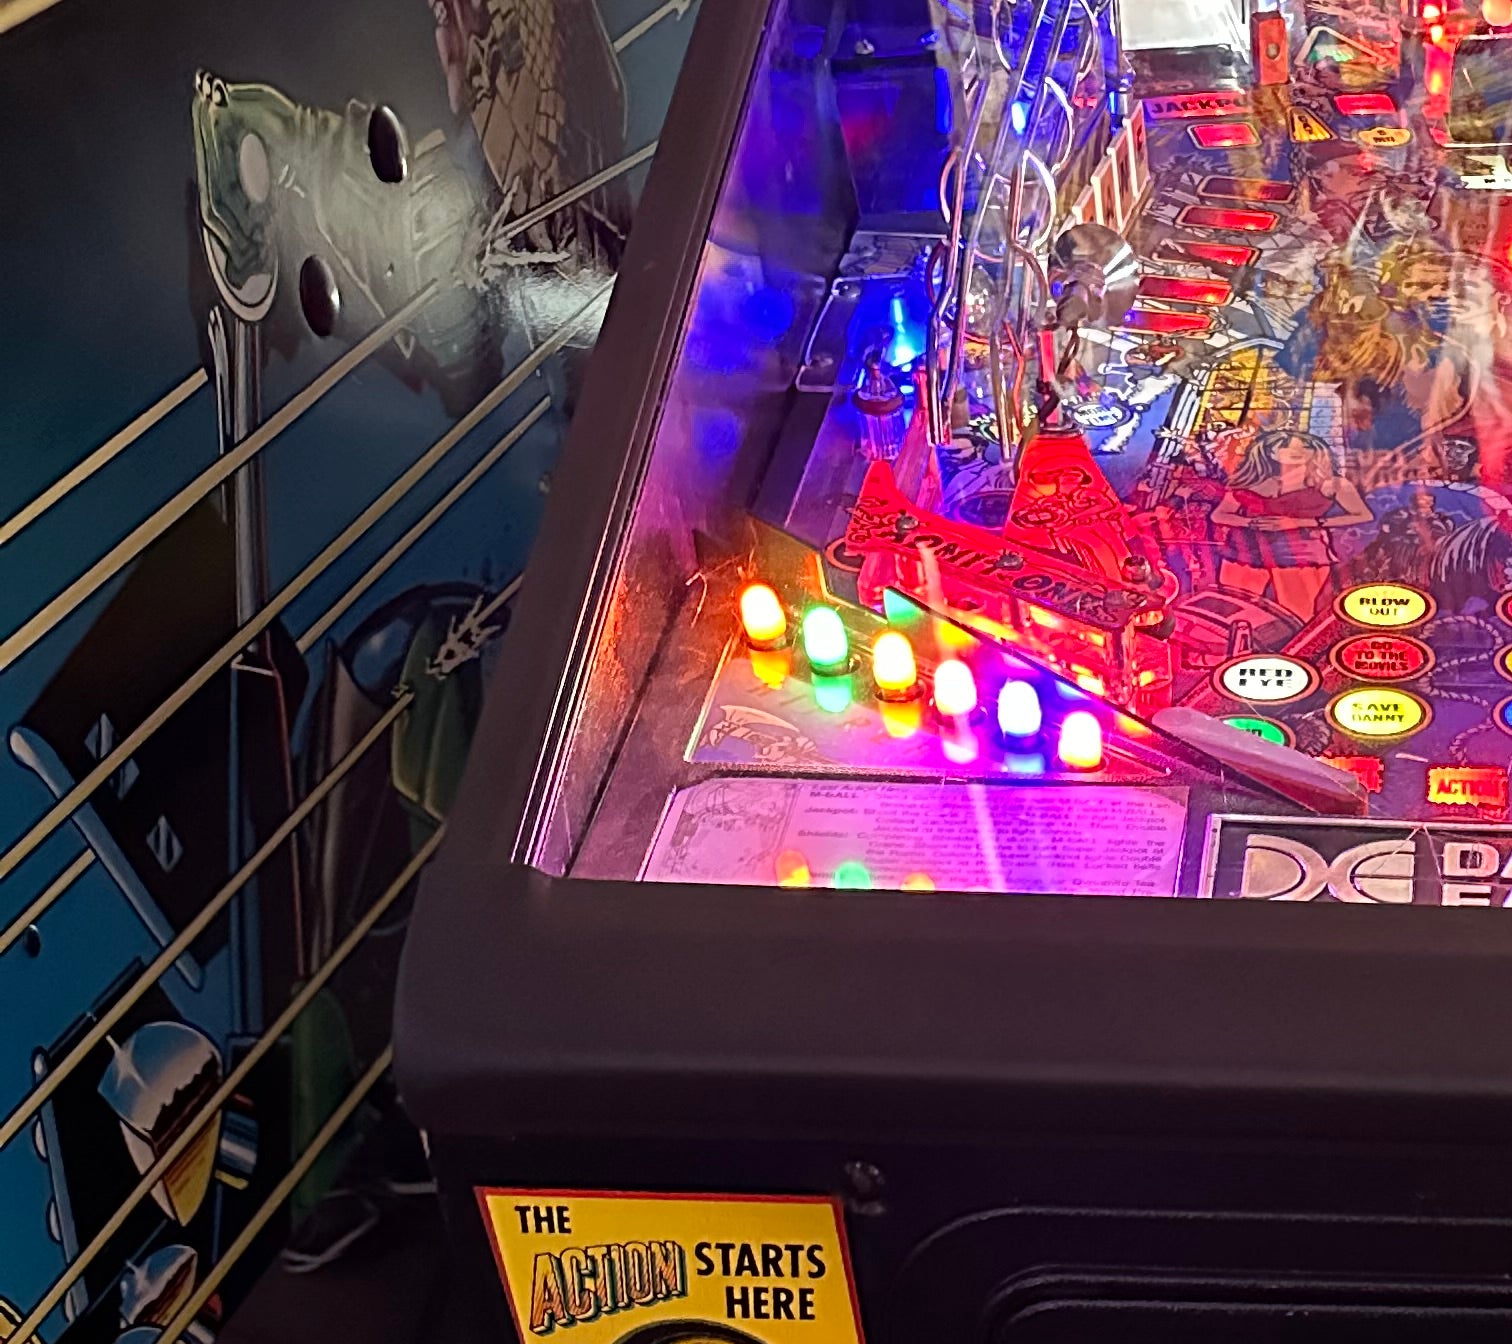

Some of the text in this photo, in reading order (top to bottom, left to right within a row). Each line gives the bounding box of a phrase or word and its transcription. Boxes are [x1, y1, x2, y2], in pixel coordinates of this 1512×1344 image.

[1360, 597, 1410, 606] BLOW
[1370, 607, 1398, 616] OUT
[1371, 641, 1393, 650] GO
[1356, 650, 1408, 661] TO THE
[1354, 661, 1409, 670] MOVIES
[514, 1204, 572, 1234] THE
[529, 1240, 827, 1334] ACTION STARTS
[725, 1286, 816, 1321] HERE
